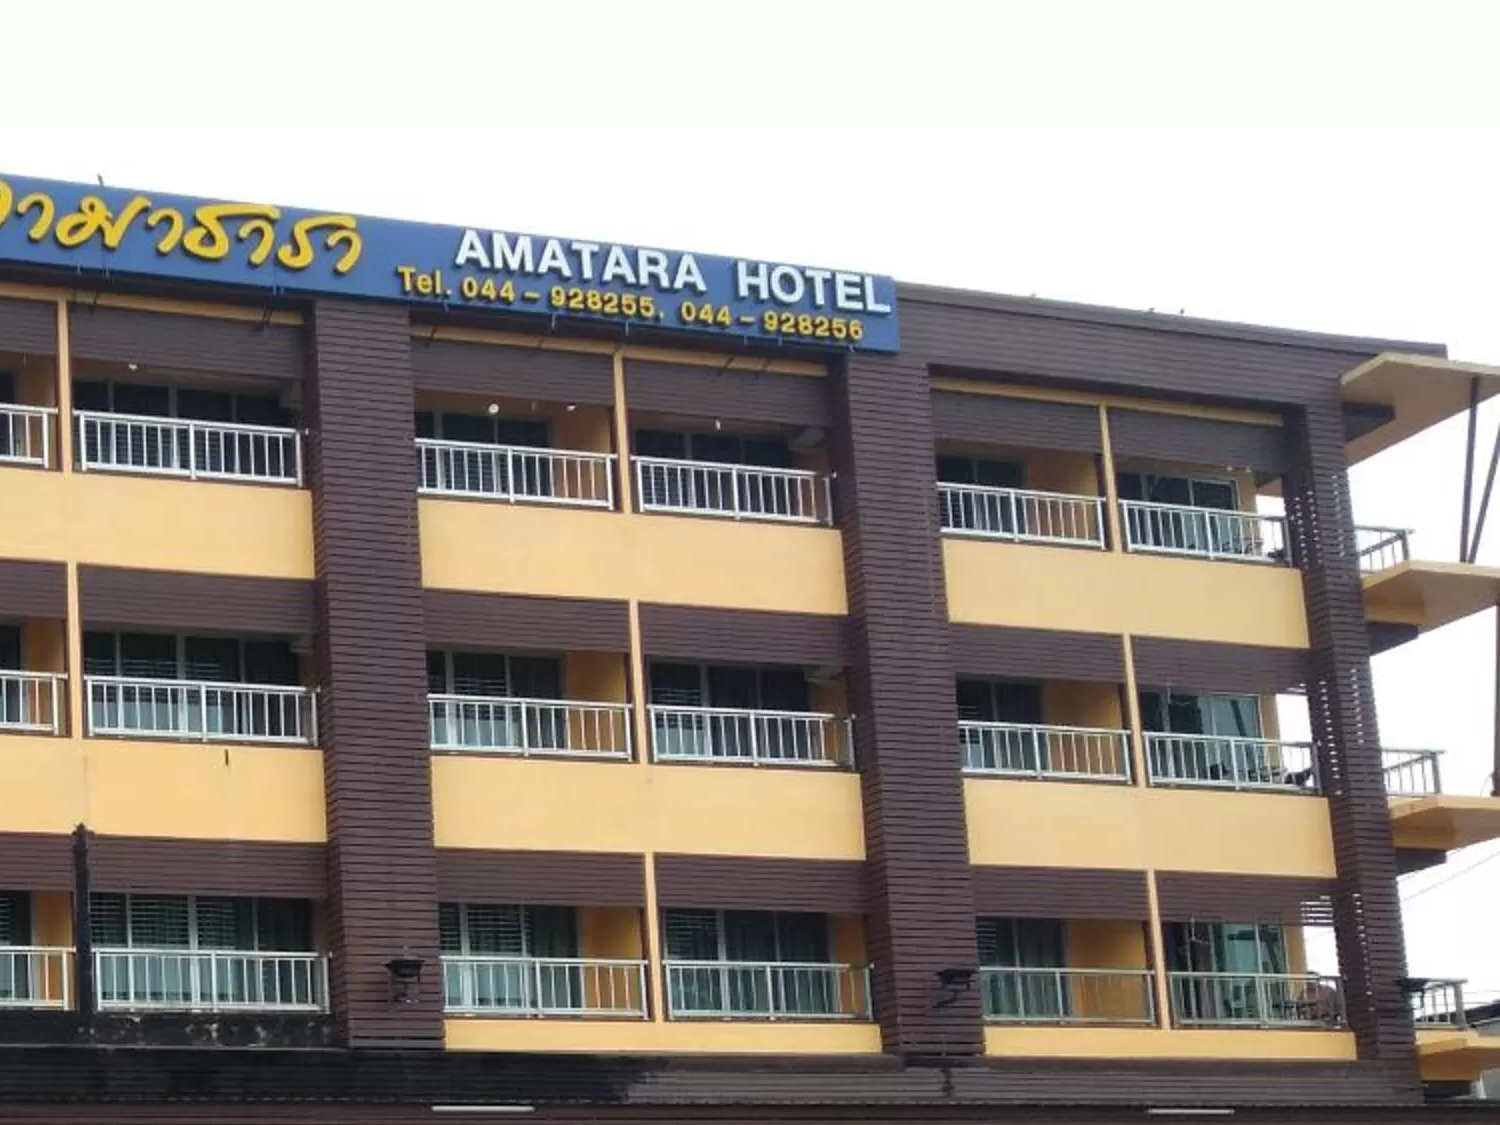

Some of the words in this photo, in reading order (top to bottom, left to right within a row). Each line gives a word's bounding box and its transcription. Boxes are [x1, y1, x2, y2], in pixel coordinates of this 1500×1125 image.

[398, 265, 452, 297] Tel.
[454, 229, 707, 292] AMATARA
[736, 260, 892, 313] HOTEL
